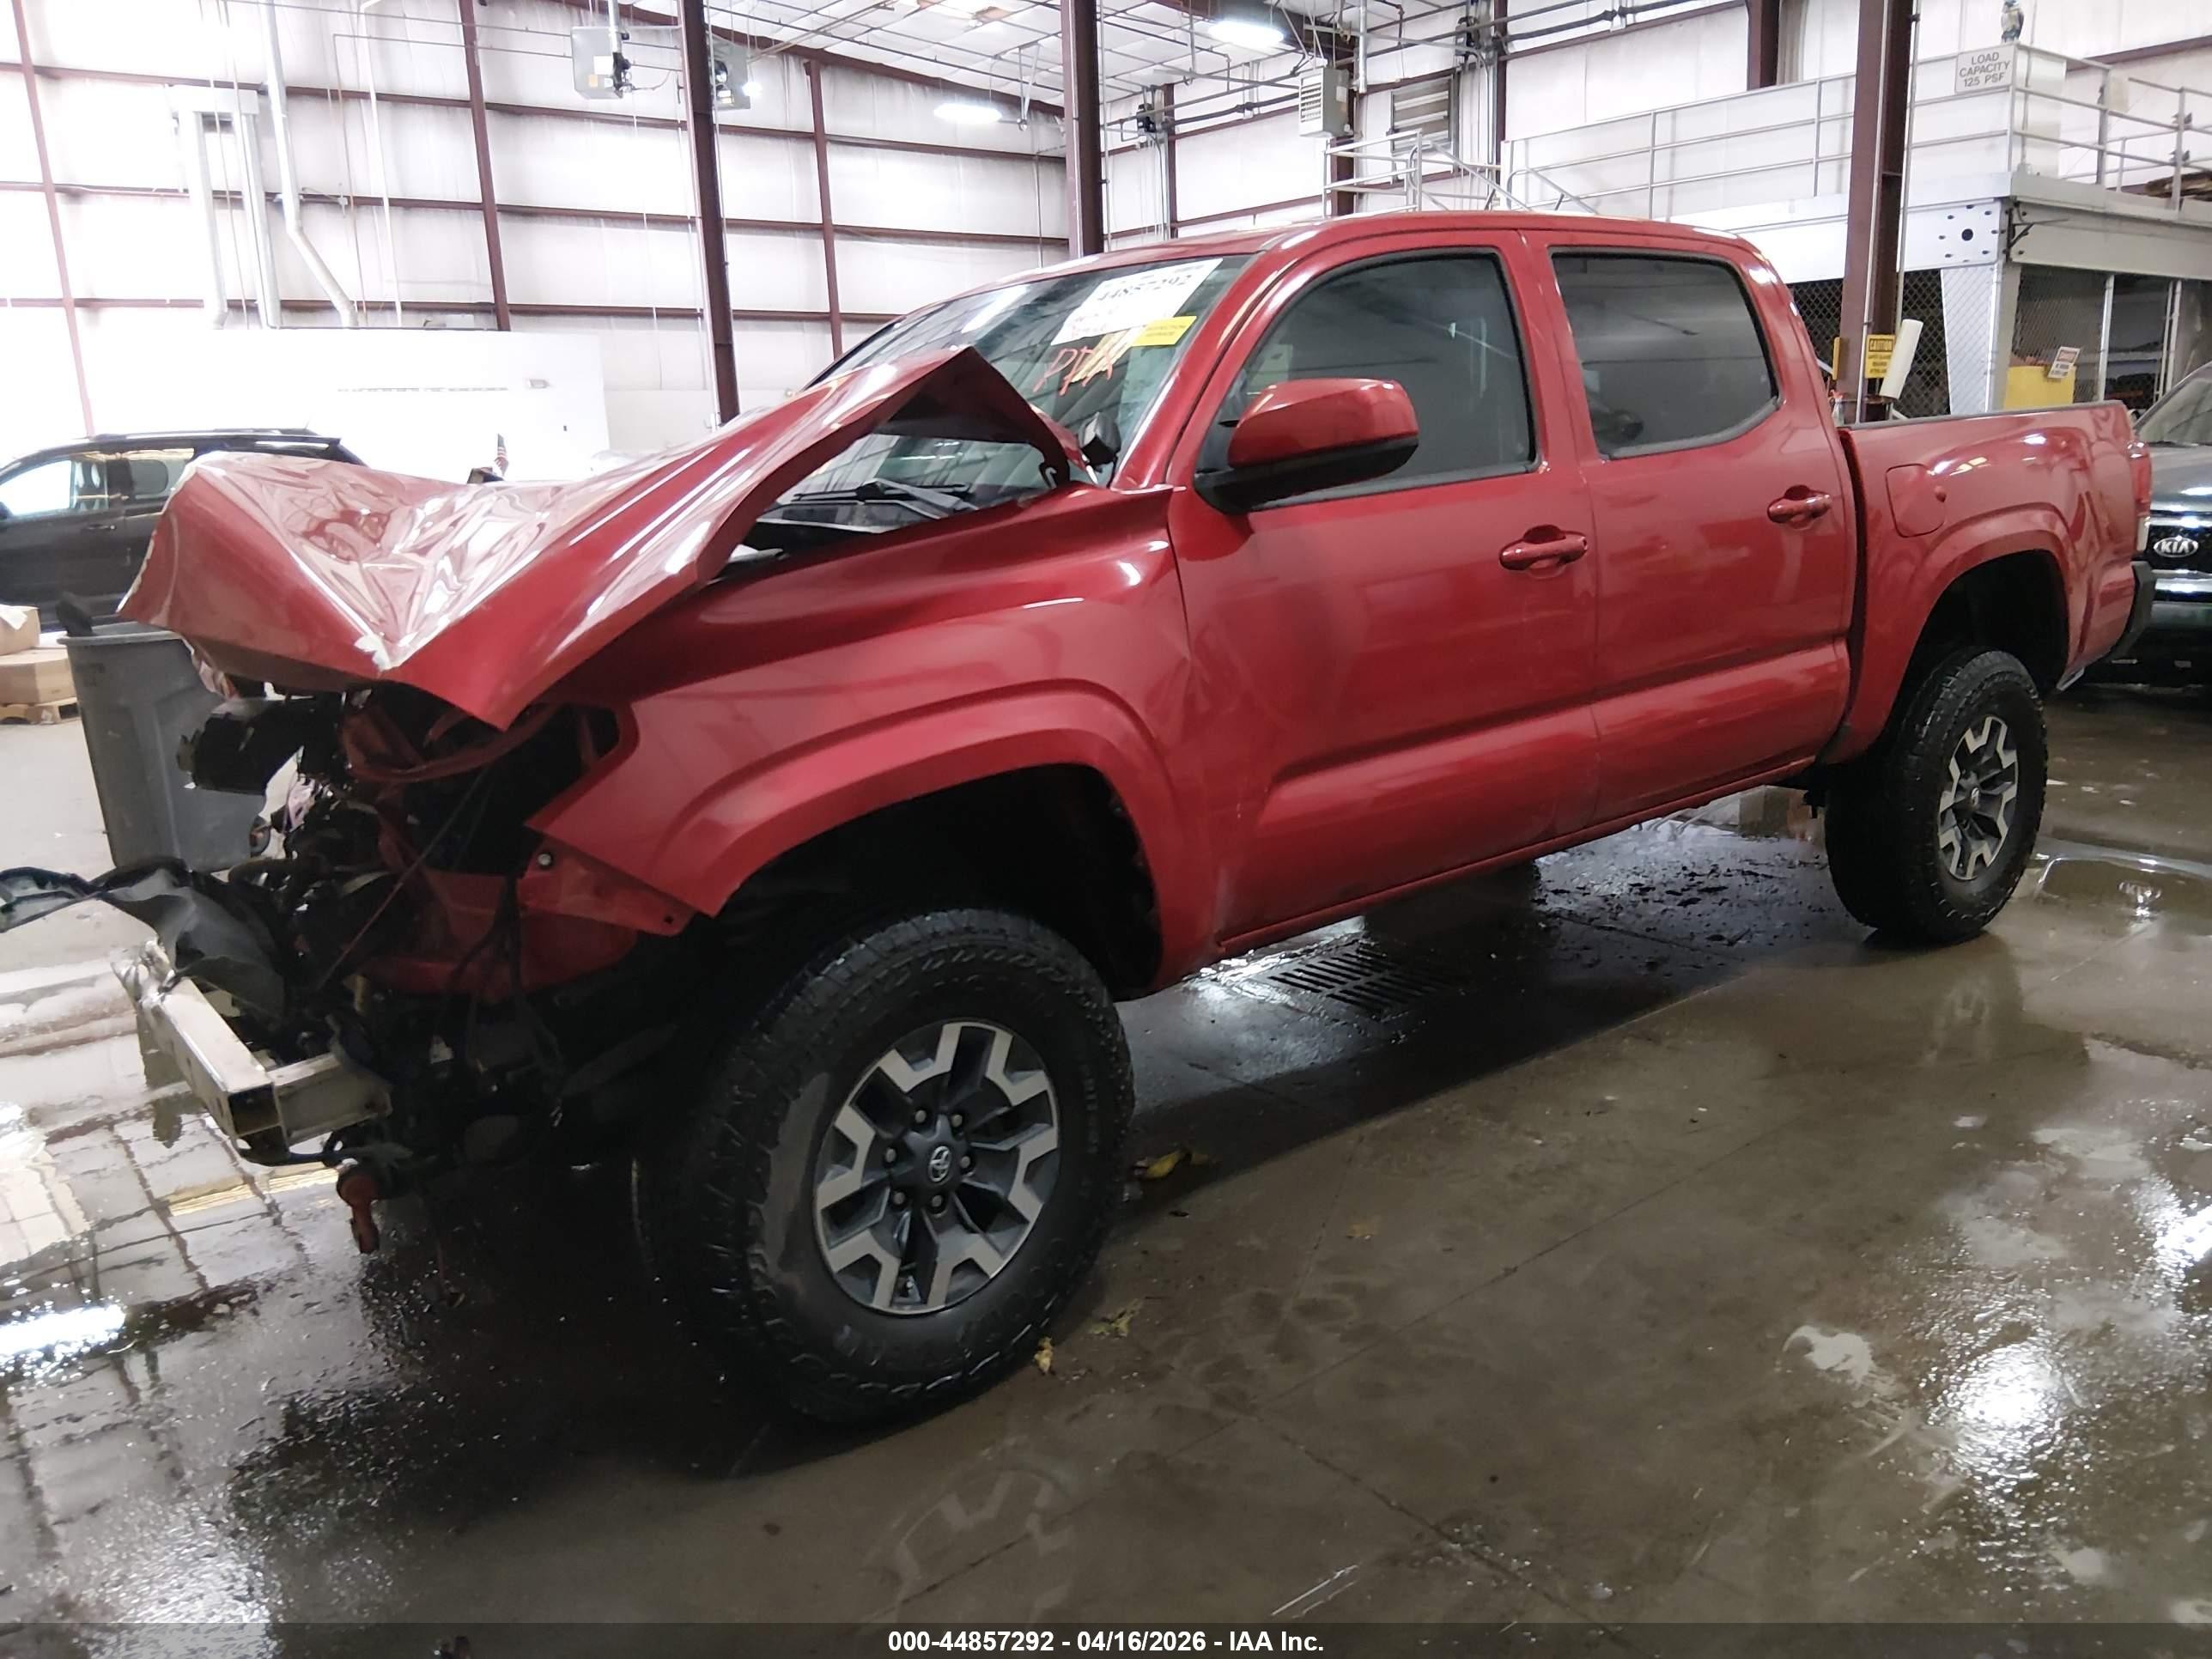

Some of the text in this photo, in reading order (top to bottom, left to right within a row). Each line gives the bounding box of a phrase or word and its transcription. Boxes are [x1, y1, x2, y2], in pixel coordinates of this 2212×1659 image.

[1971, 52, 2000, 65] LOAD
[1959, 60, 2011, 77] CAPACITY
[1964, 72, 2005, 87] 125 PSF
[2160, 540, 2190, 553] KIA
